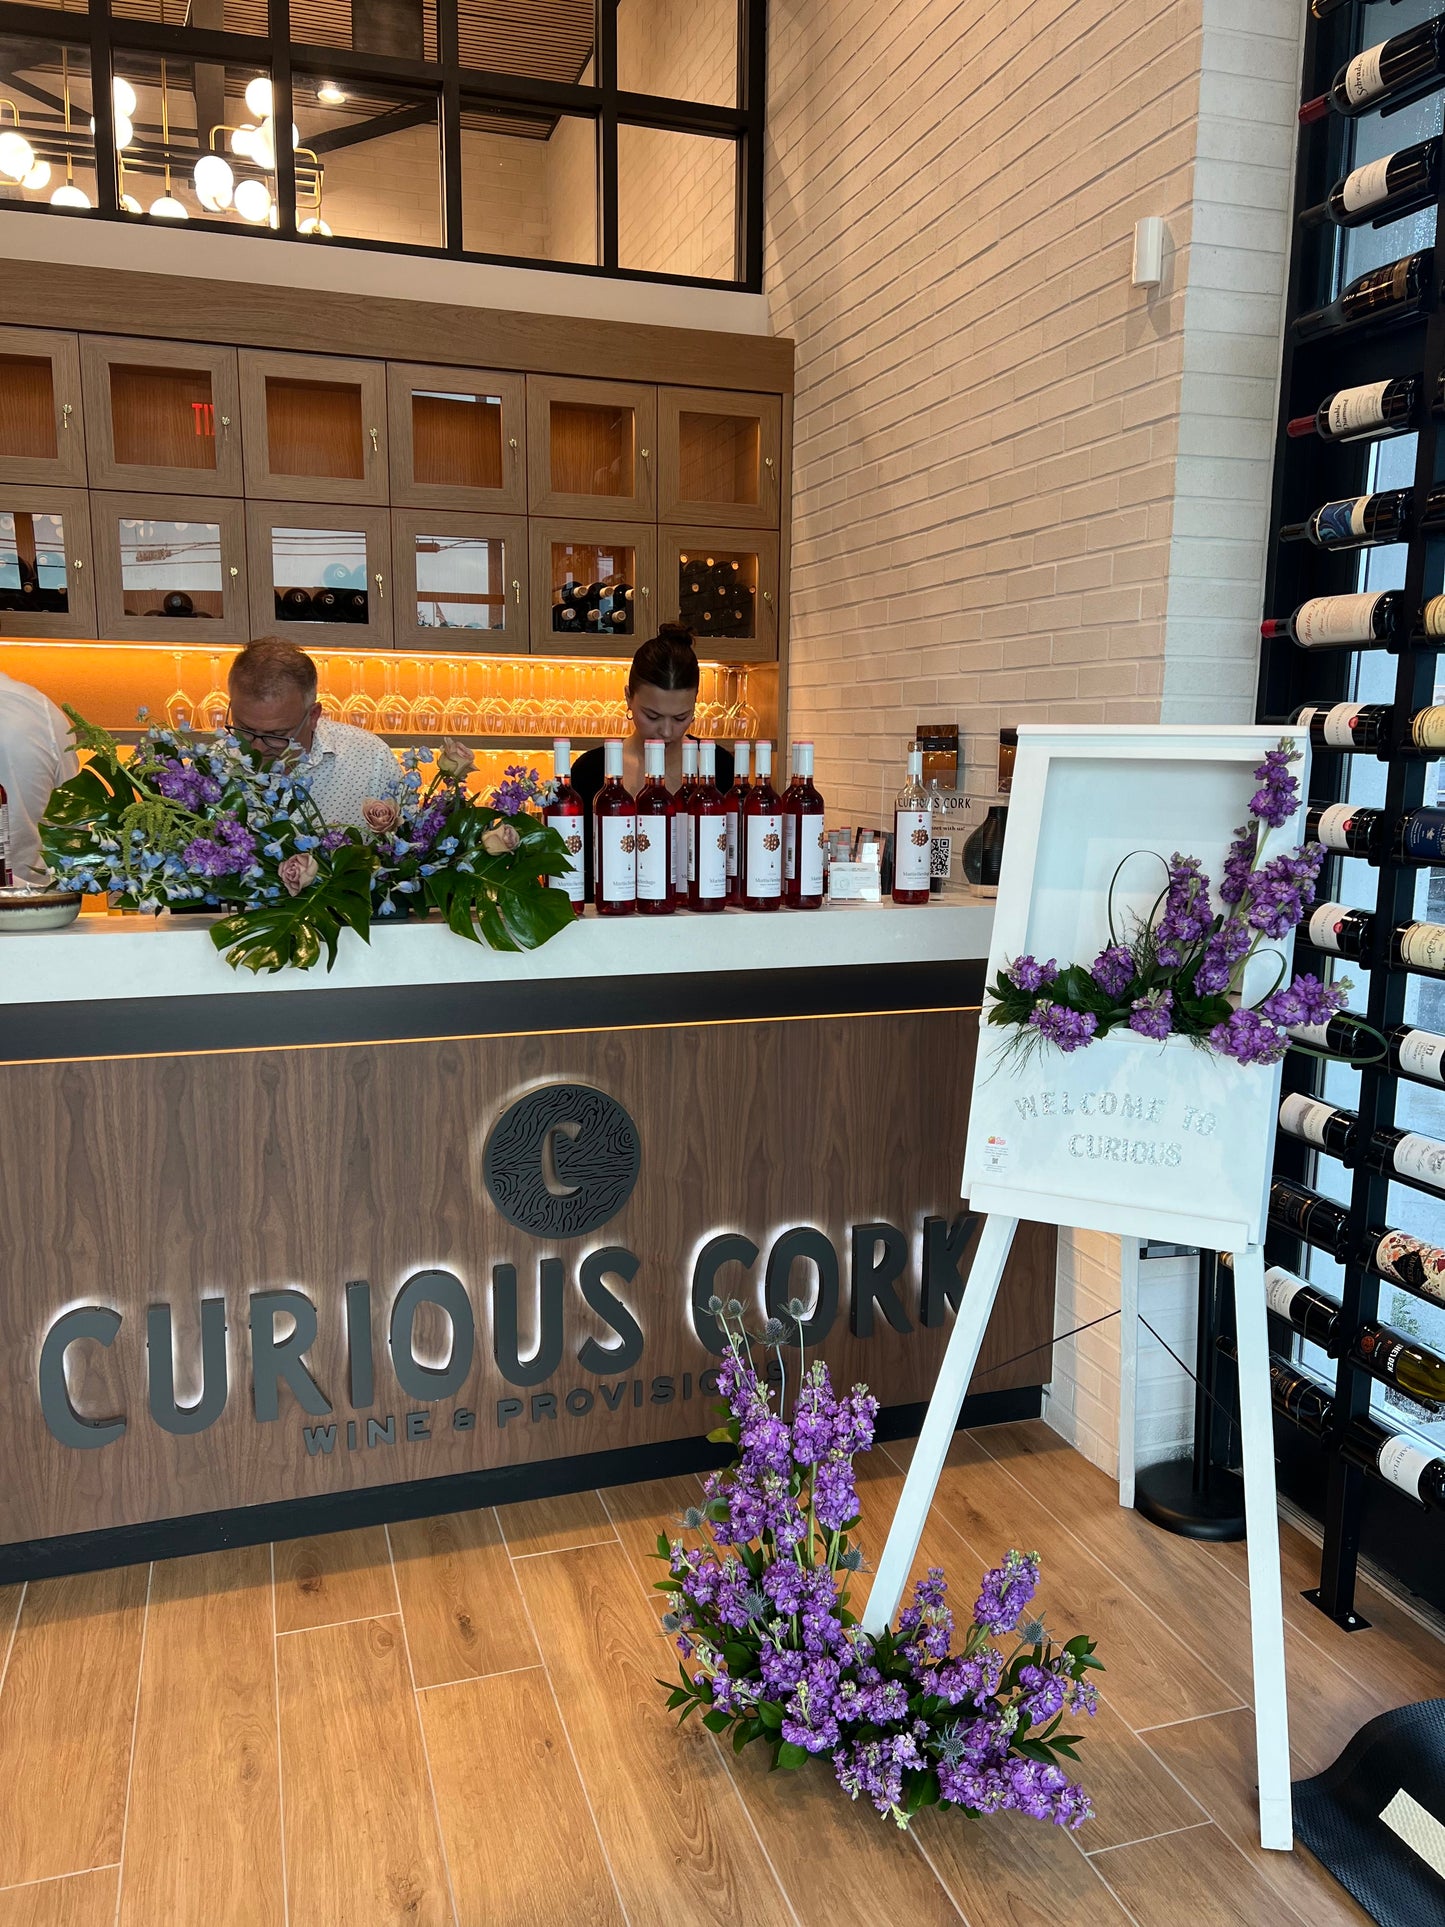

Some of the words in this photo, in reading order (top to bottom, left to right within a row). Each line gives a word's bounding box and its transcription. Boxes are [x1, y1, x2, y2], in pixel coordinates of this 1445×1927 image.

[1333, 403, 1342, 431] Double
[1342, 398, 1350, 433] Diamond
[943, 797, 971, 809] CORK
[1014, 1091, 1166, 1124] WELCOME
[1182, 1104, 1217, 1137] TO
[542, 1121, 583, 1200] C
[1068, 1133, 1183, 1167] CURIOUS
[38, 1246, 647, 1451] CURIOUS
[691, 1212, 979, 1357] CORK
[302, 1406, 433, 1456] WINE
[453, 1400, 476, 1430] &
[497, 1360, 792, 1429] PROVISIOS
